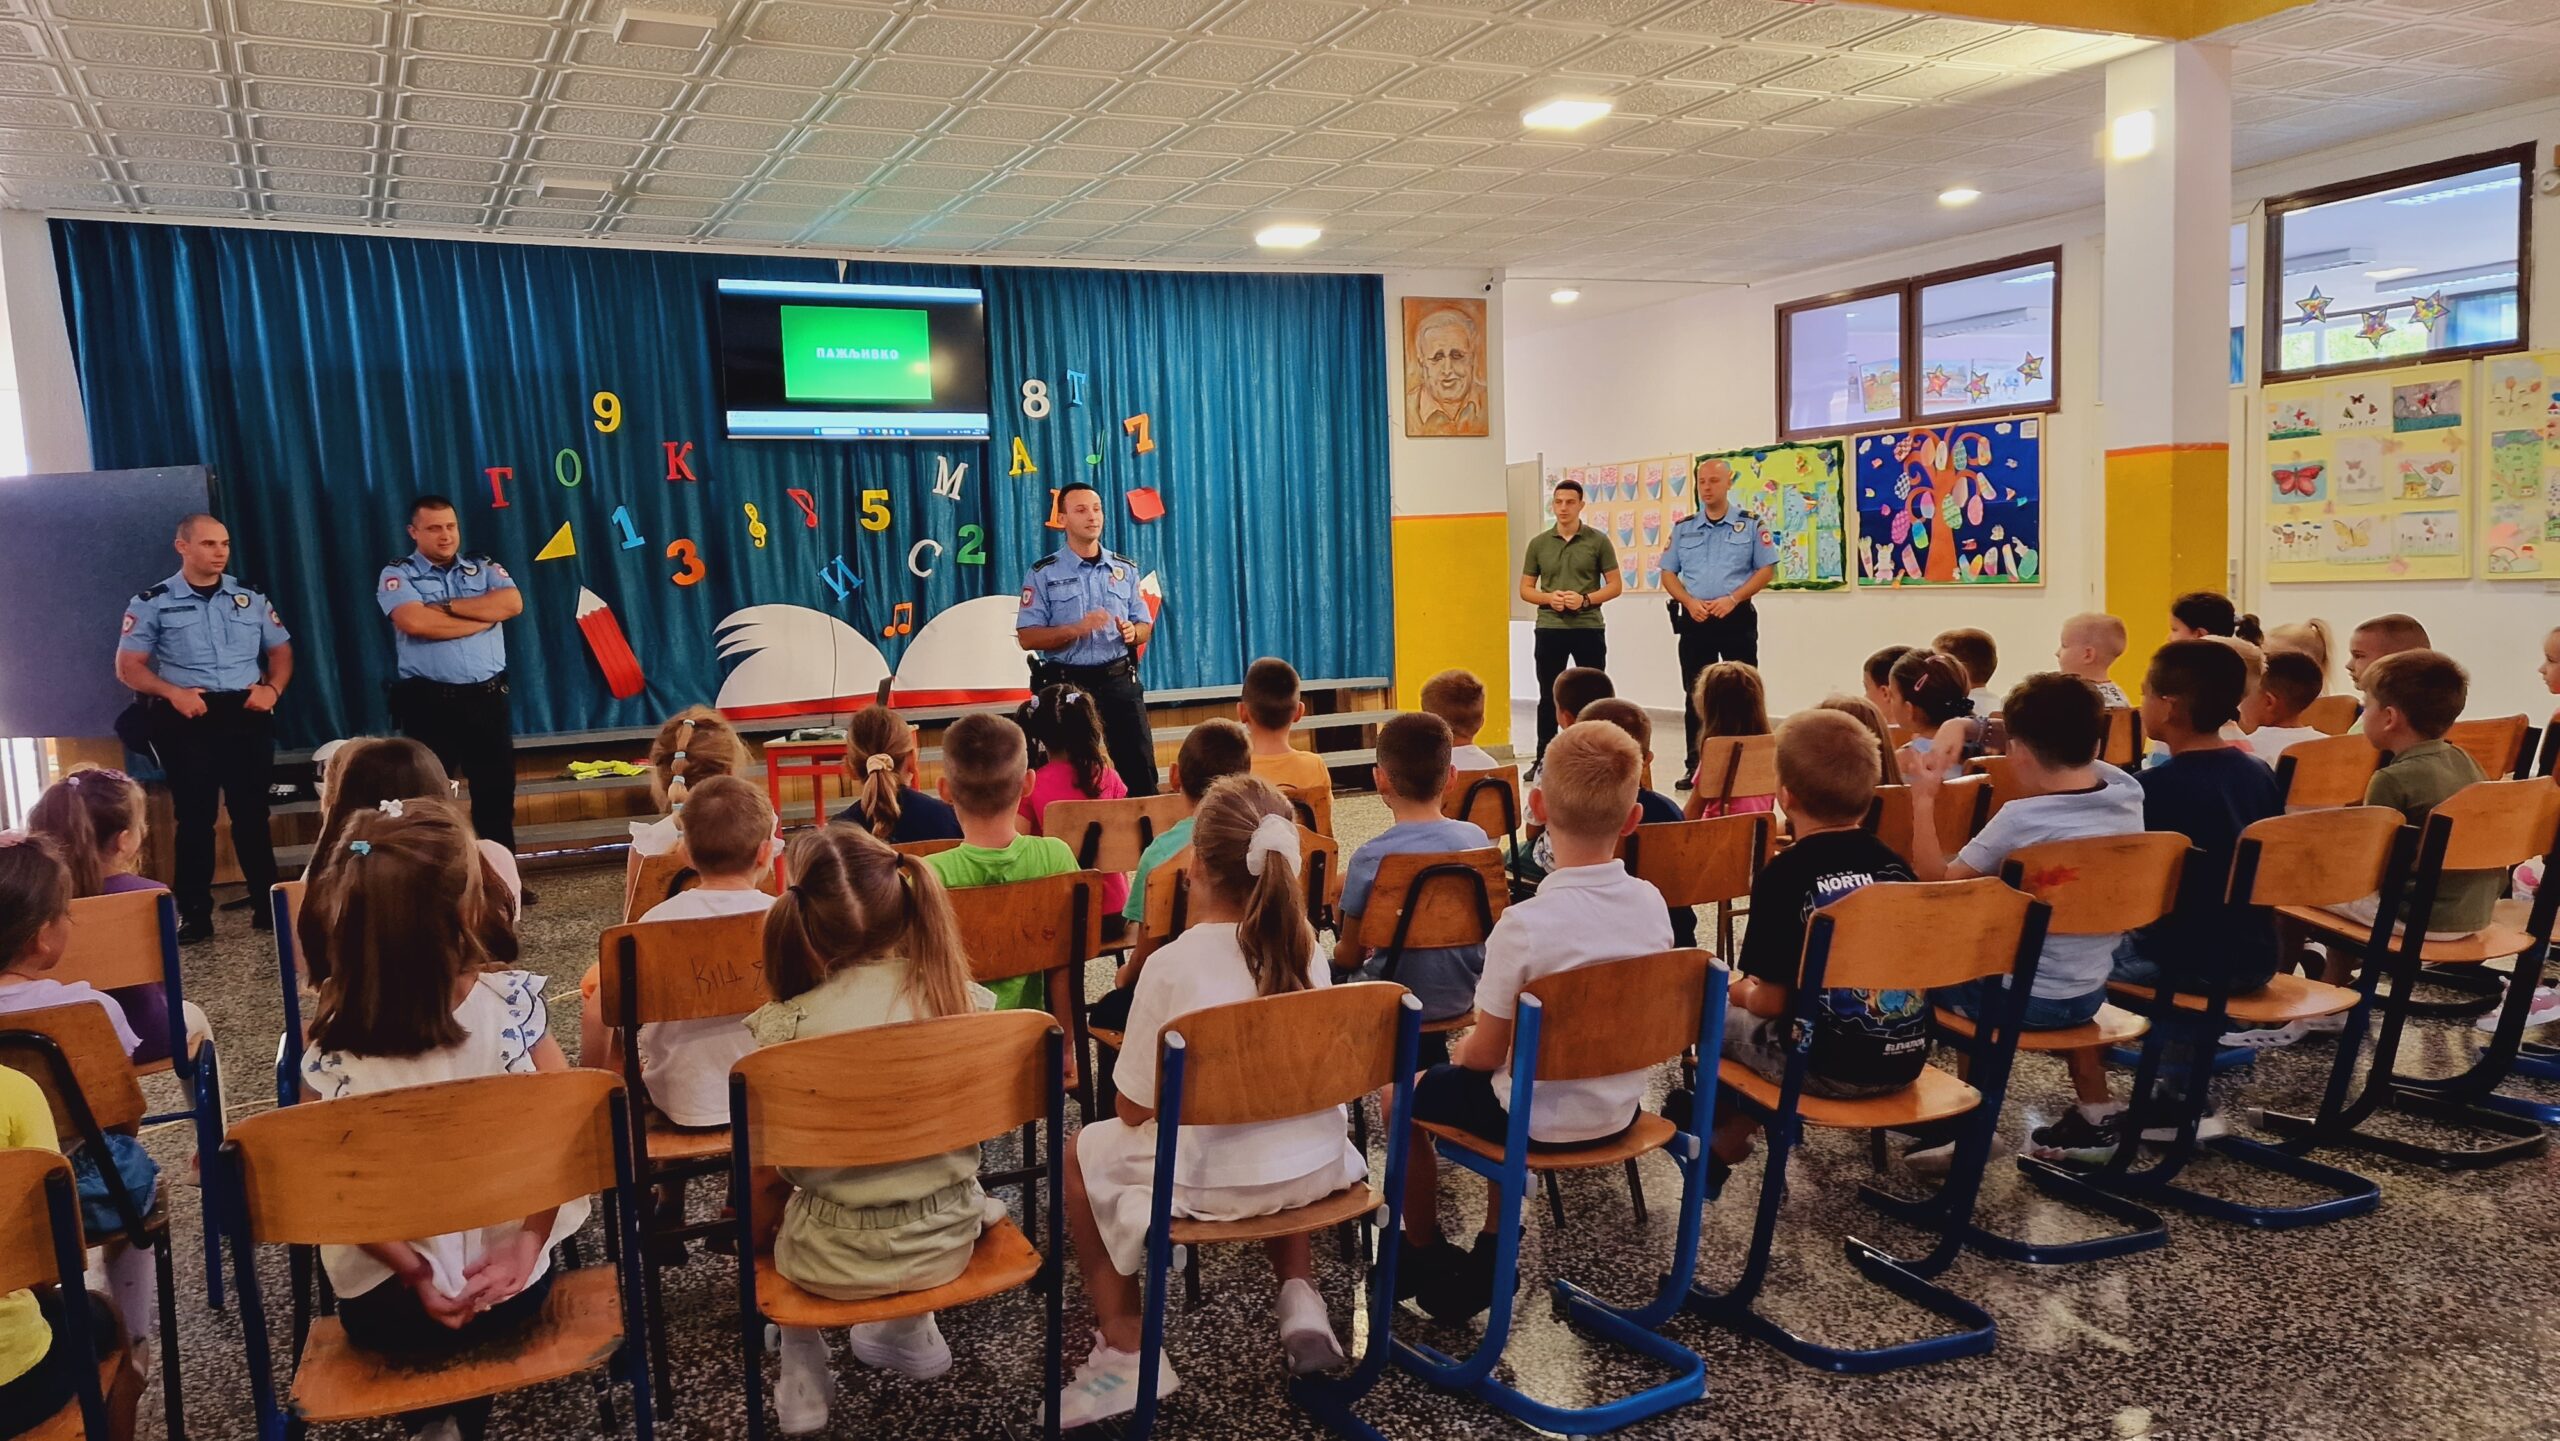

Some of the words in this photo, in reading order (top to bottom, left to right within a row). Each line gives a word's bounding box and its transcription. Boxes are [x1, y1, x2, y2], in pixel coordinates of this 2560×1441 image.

[593, 391, 622, 433] 9
[1022, 378, 1050, 418] 8
[1124, 413, 1154, 453] 7
[484, 467, 513, 508] Г
[611, 505, 646, 550] 1
[860, 489, 891, 531] 5
[666, 538, 706, 586] 3
[956, 523, 987, 564] 2
[1816, 872, 1874, 895] NORTH
